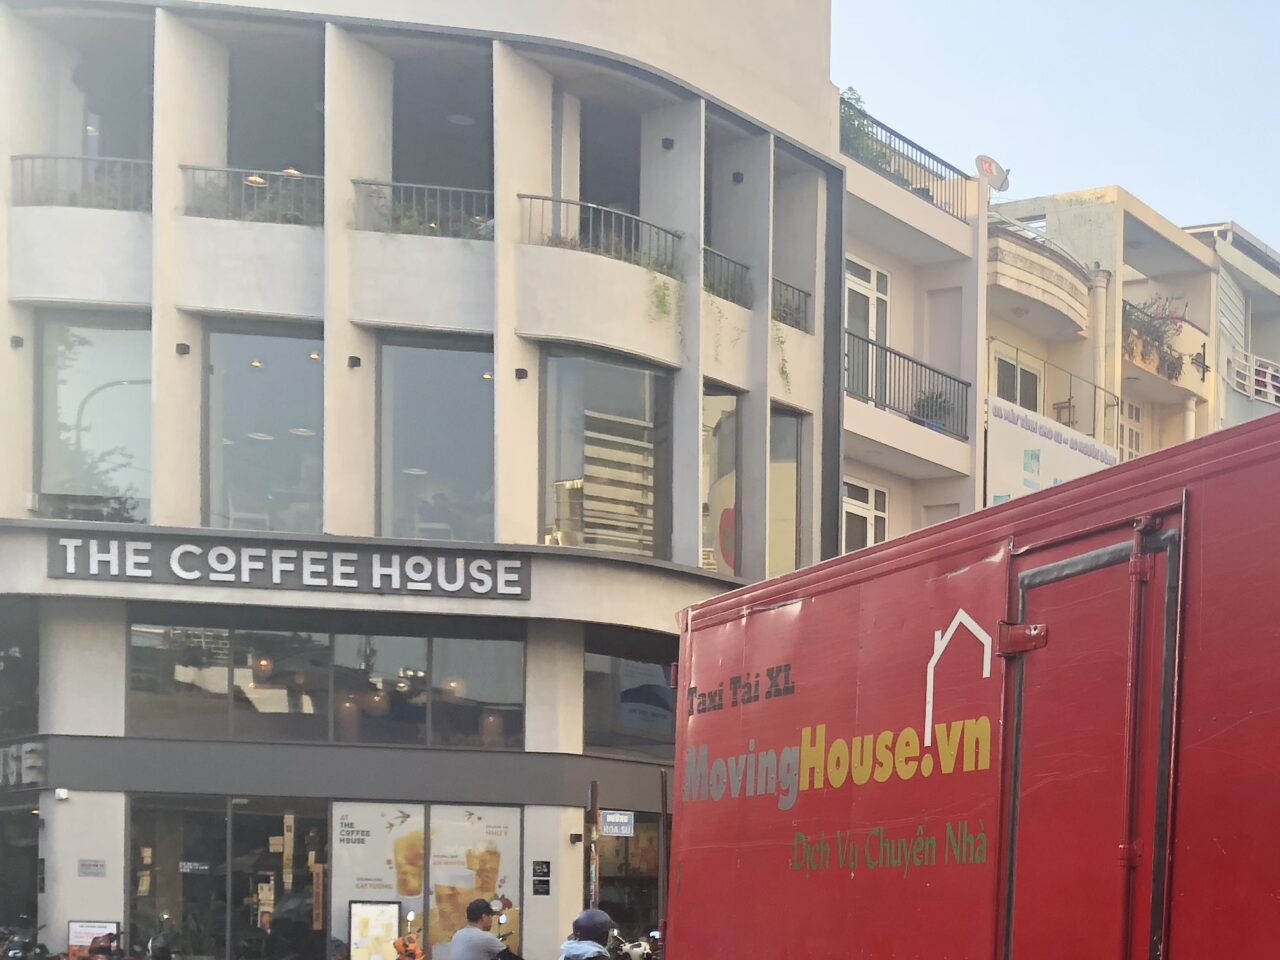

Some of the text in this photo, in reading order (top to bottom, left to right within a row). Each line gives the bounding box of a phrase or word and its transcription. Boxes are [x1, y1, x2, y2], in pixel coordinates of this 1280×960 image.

[59, 538, 522, 595] THE COFFEE HOUSE
[688, 682, 724, 717] Taxi
[765, 663, 796, 699] XL
[339, 837, 366, 845] HOUSE
[945, 818, 988, 865] Nhà
